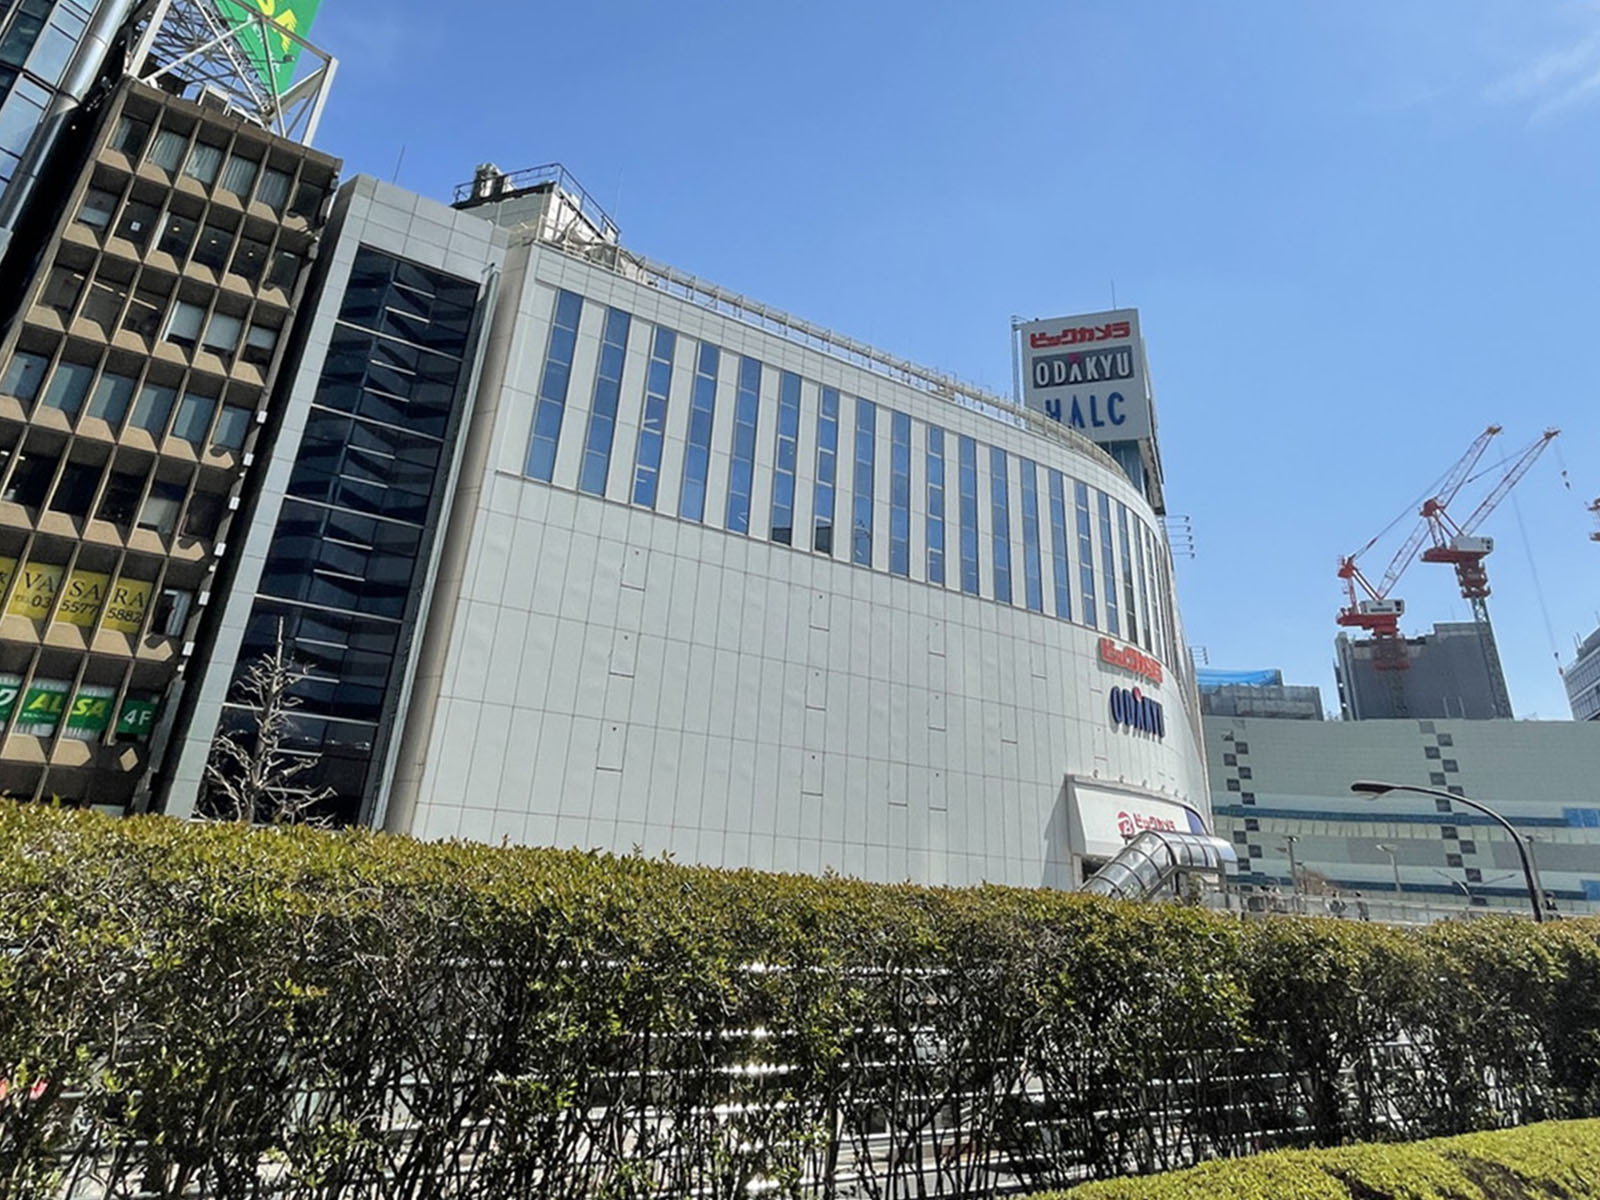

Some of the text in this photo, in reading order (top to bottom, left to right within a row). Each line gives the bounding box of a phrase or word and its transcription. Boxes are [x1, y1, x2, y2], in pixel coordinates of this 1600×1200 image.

[1030, 321, 1130, 349] ビックカメラ
[1035, 352, 1130, 386] ODAKYU
[1045, 392, 1126, 429] HALC
[124, 709, 152, 725] 4F
